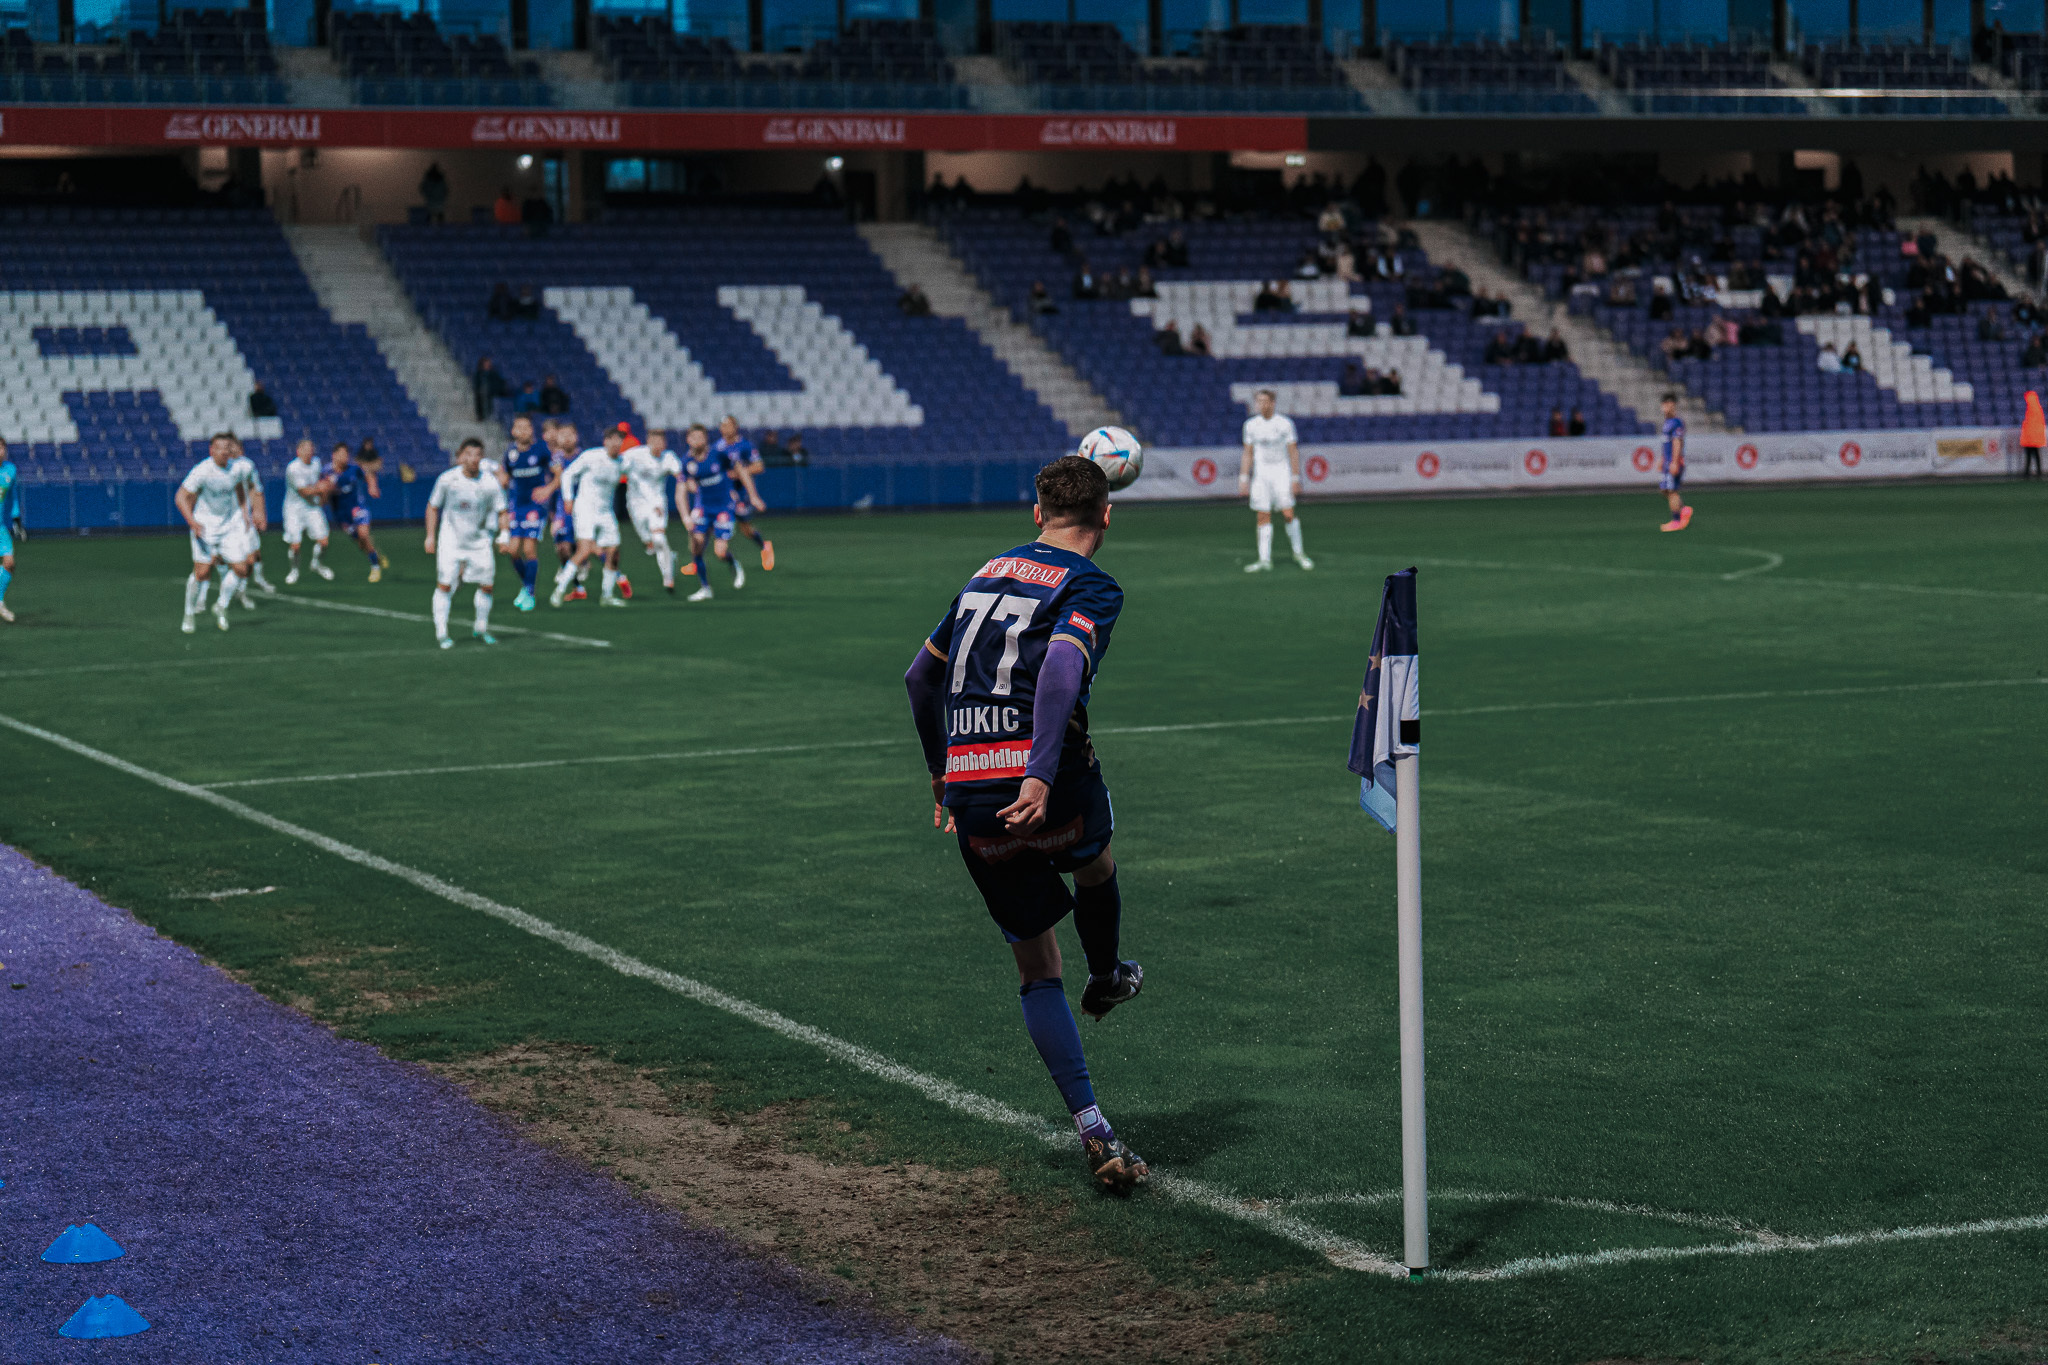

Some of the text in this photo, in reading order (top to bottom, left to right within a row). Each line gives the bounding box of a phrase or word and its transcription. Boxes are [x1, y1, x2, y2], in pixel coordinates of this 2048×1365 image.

[202, 114, 321, 140] GENERALI
[507, 116, 622, 142] GENERALI
[990, 559, 1064, 585] GENERALI
[951, 591, 1041, 695] 77
[950, 705, 1020, 737] JUKIC
